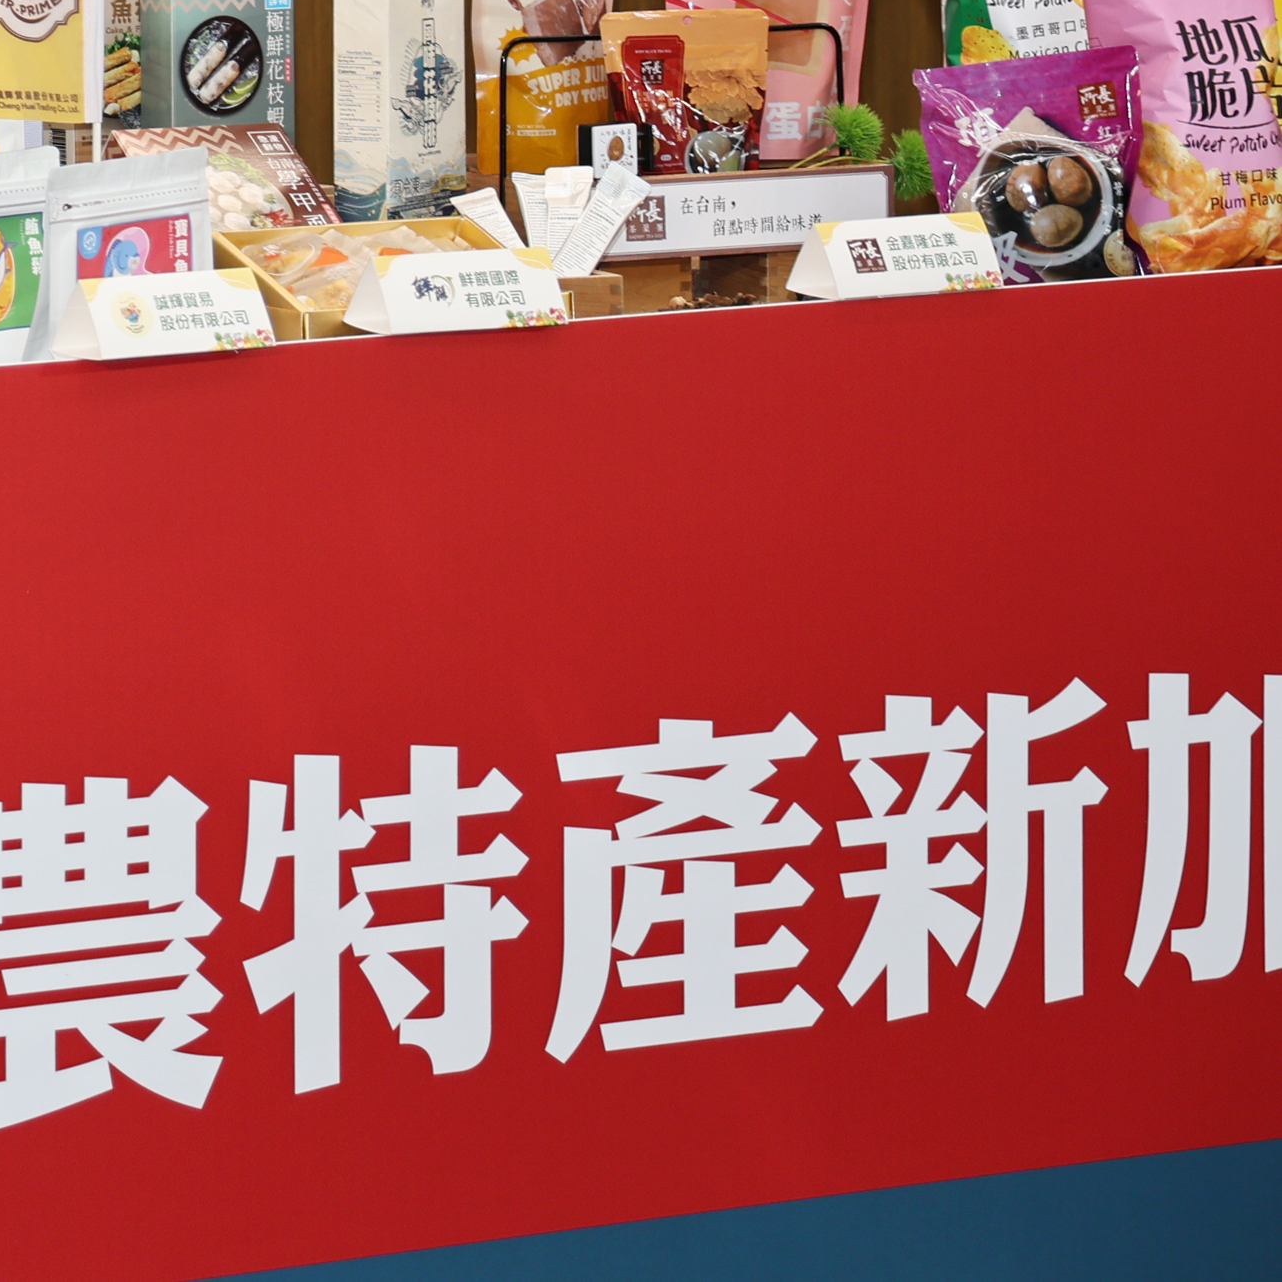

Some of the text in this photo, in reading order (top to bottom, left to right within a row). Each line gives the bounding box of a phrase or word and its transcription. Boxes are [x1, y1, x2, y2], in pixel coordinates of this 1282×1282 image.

[105, 26, 124, 34] Cake
[1176, 16, 1275, 65] 地瓜
[1009, 45, 1070, 60] Mexican
[266, 10, 285, 128] 極鮮花枝蝦
[527, 67, 581, 96] SUPER
[554, 86, 609, 108] DRY TOFU
[1079, 84, 1115, 105] 所長
[1185, 65, 1271, 122] 脆片
[21, 102, 36, 110] Huei
[36, 103, 57, 114] Trading
[1180, 133, 1226, 153] Sweet
[1219, 168, 1279, 187] 甘梅口味
[1210, 195, 1247, 211] Plum
[849, 240, 882, 260] 所長
[886, 232, 958, 251] 金嘉隆企業
[892, 250, 979, 271] 股份有限公司
[458, 270, 521, 288] 鮮饌國際
[153, 291, 214, 310] 誠輝貿易
[465, 289, 527, 308] 有限公司
[159, 309, 250, 332] 股份有限公司
